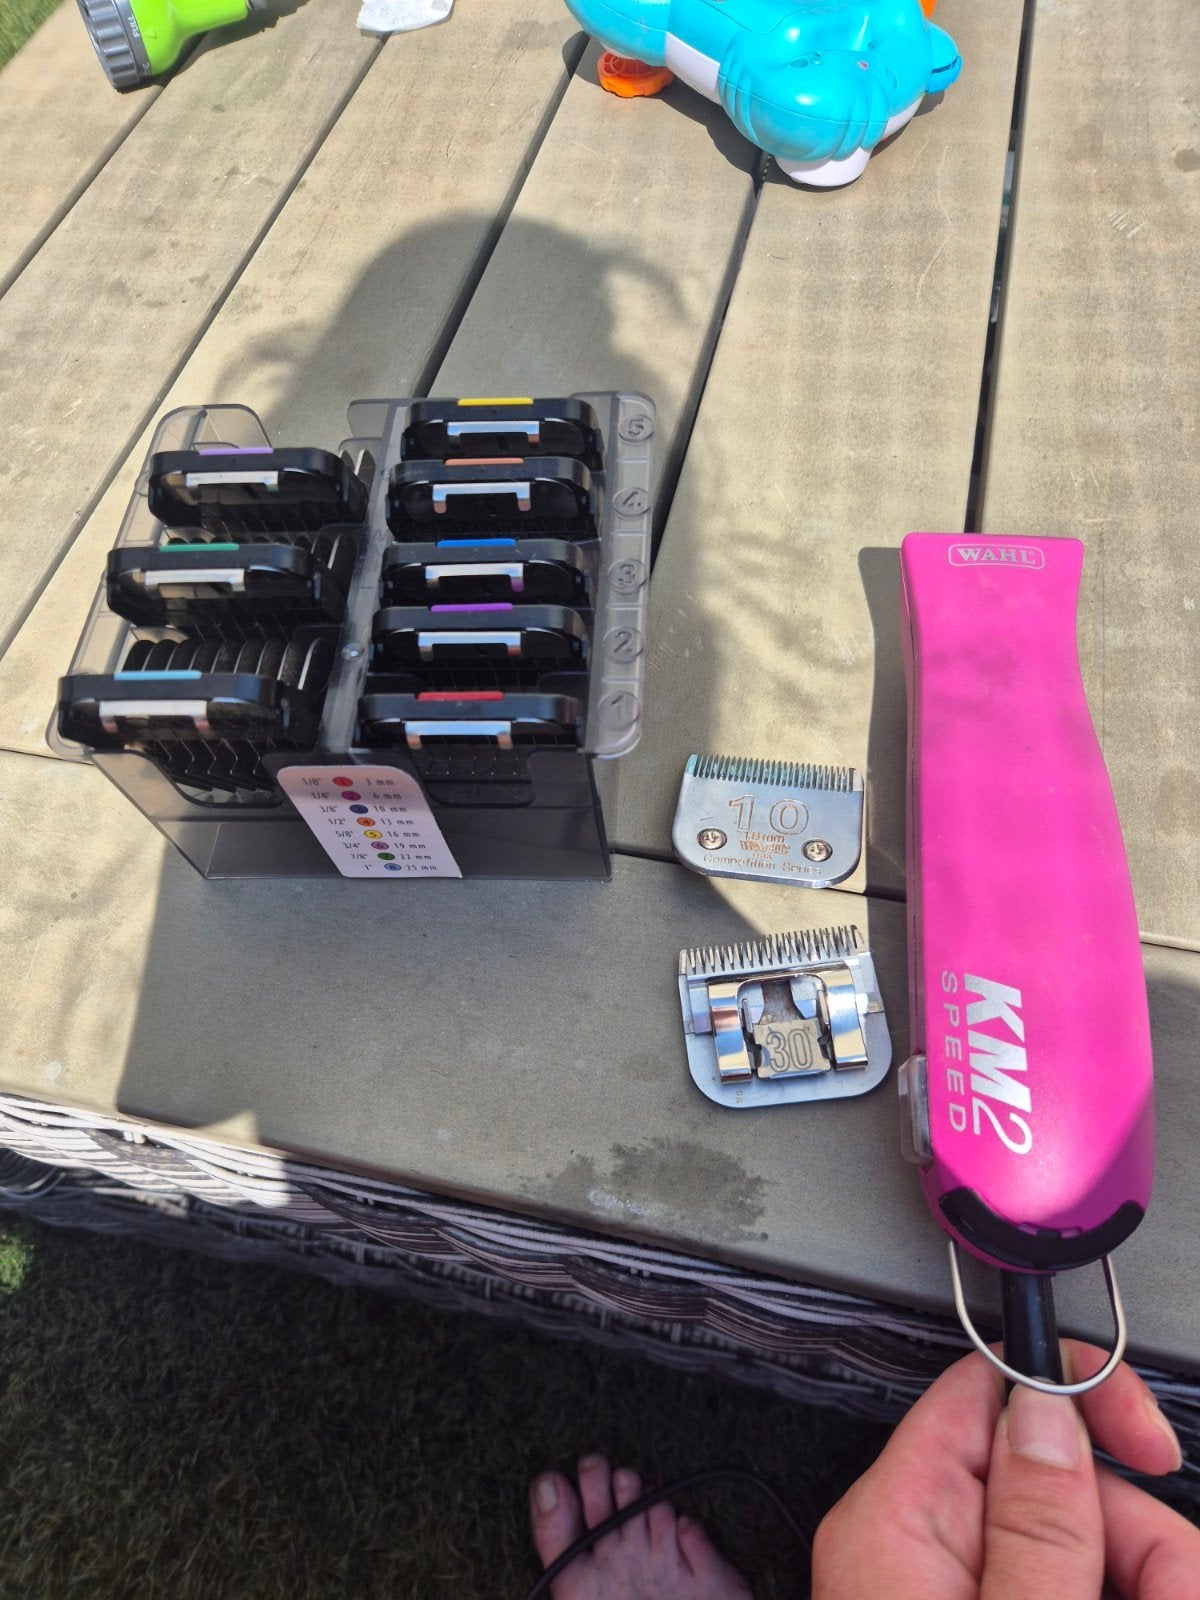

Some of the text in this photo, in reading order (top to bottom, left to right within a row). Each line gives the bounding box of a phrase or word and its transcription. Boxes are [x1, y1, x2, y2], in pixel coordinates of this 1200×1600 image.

[128, 13, 141, 38] FULL
[957, 548, 1036, 565] WAHL
[365, 777, 372, 786] 3
[373, 792, 380, 800] 6
[373, 805, 386, 813] 10
[728, 794, 810, 836] 10
[381, 818, 392, 826] 13
[335, 830, 354, 838] 5/8"
[387, 830, 400, 838] 16
[703, 852, 822, 876] Competition Series
[765, 1028, 814, 1073] 30
[941, 970, 967, 1133] SPEED
[963, 973, 1033, 1155] KM2
